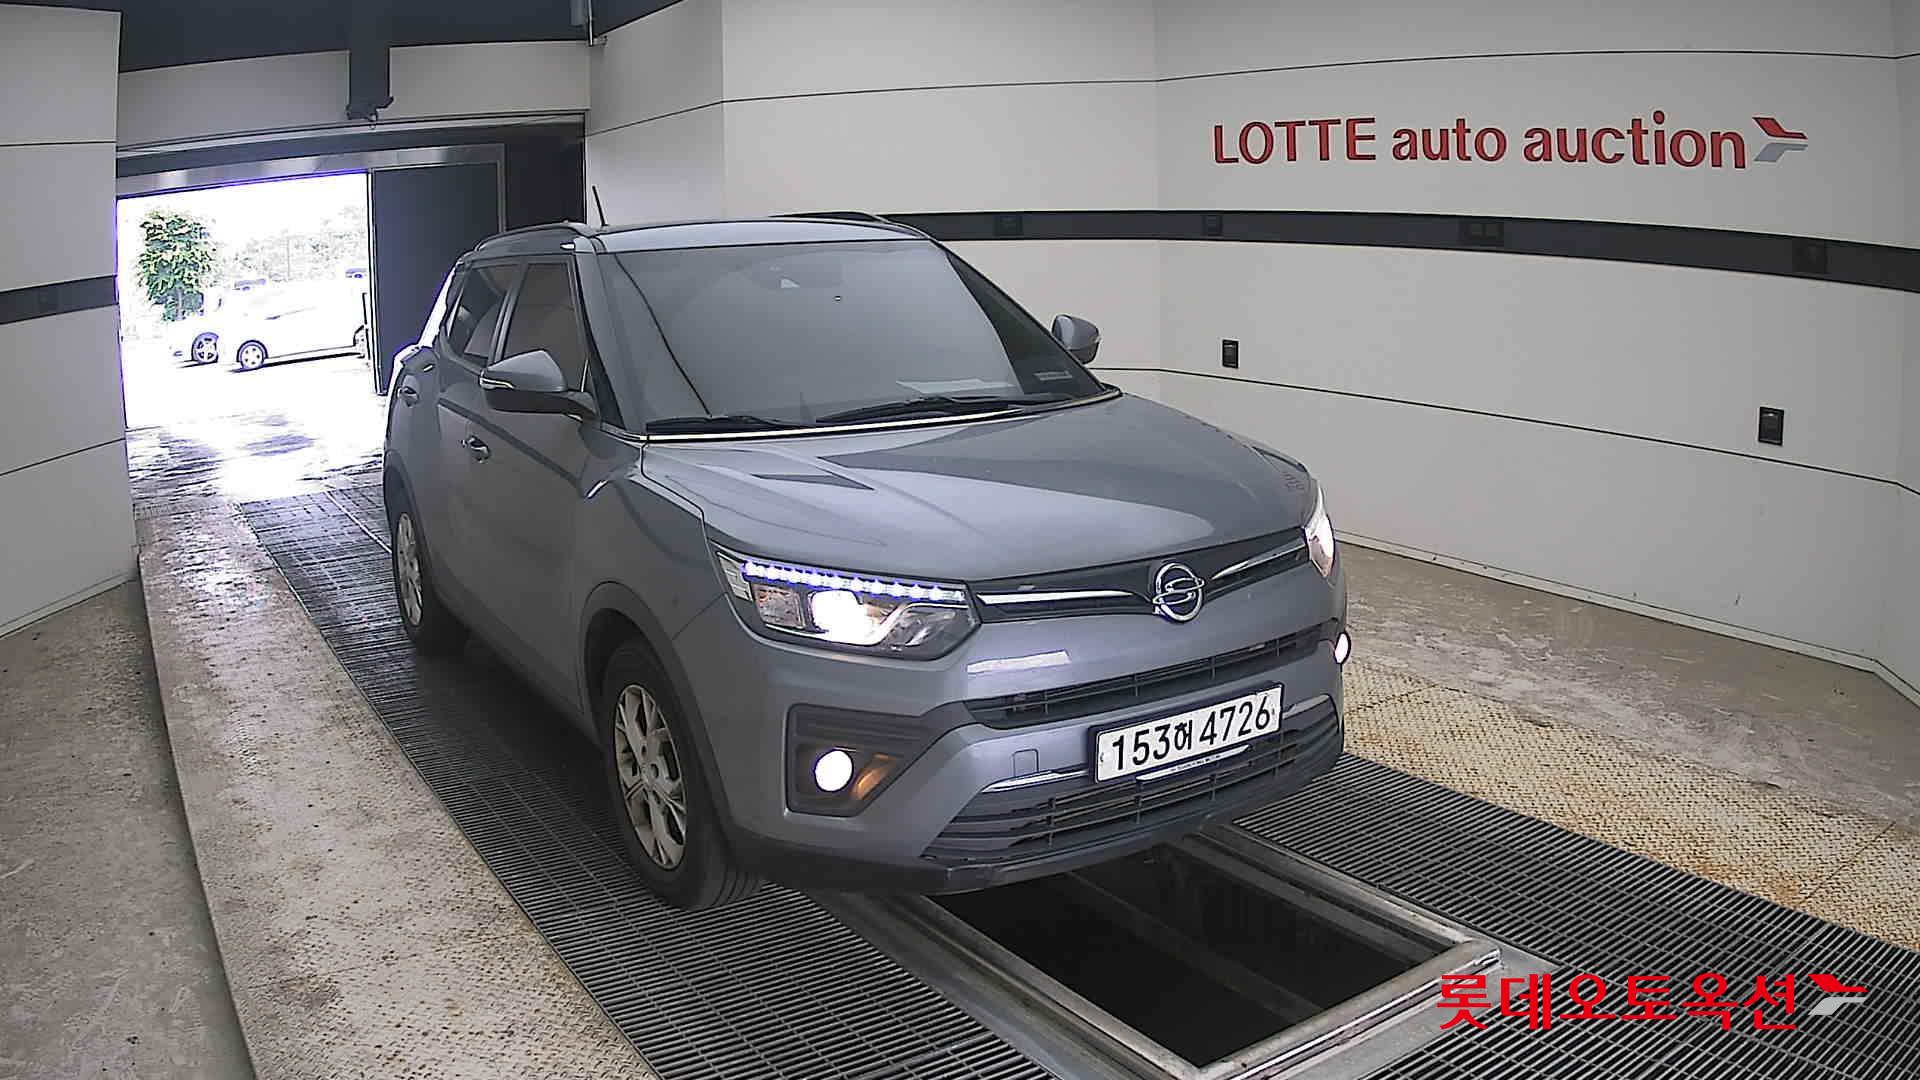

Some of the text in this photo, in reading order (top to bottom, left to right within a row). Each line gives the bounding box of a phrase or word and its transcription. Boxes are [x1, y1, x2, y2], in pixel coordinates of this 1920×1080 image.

[1213, 110, 1746, 168] LOTTE auto auction
[1199, 695, 1271, 746] 4726
